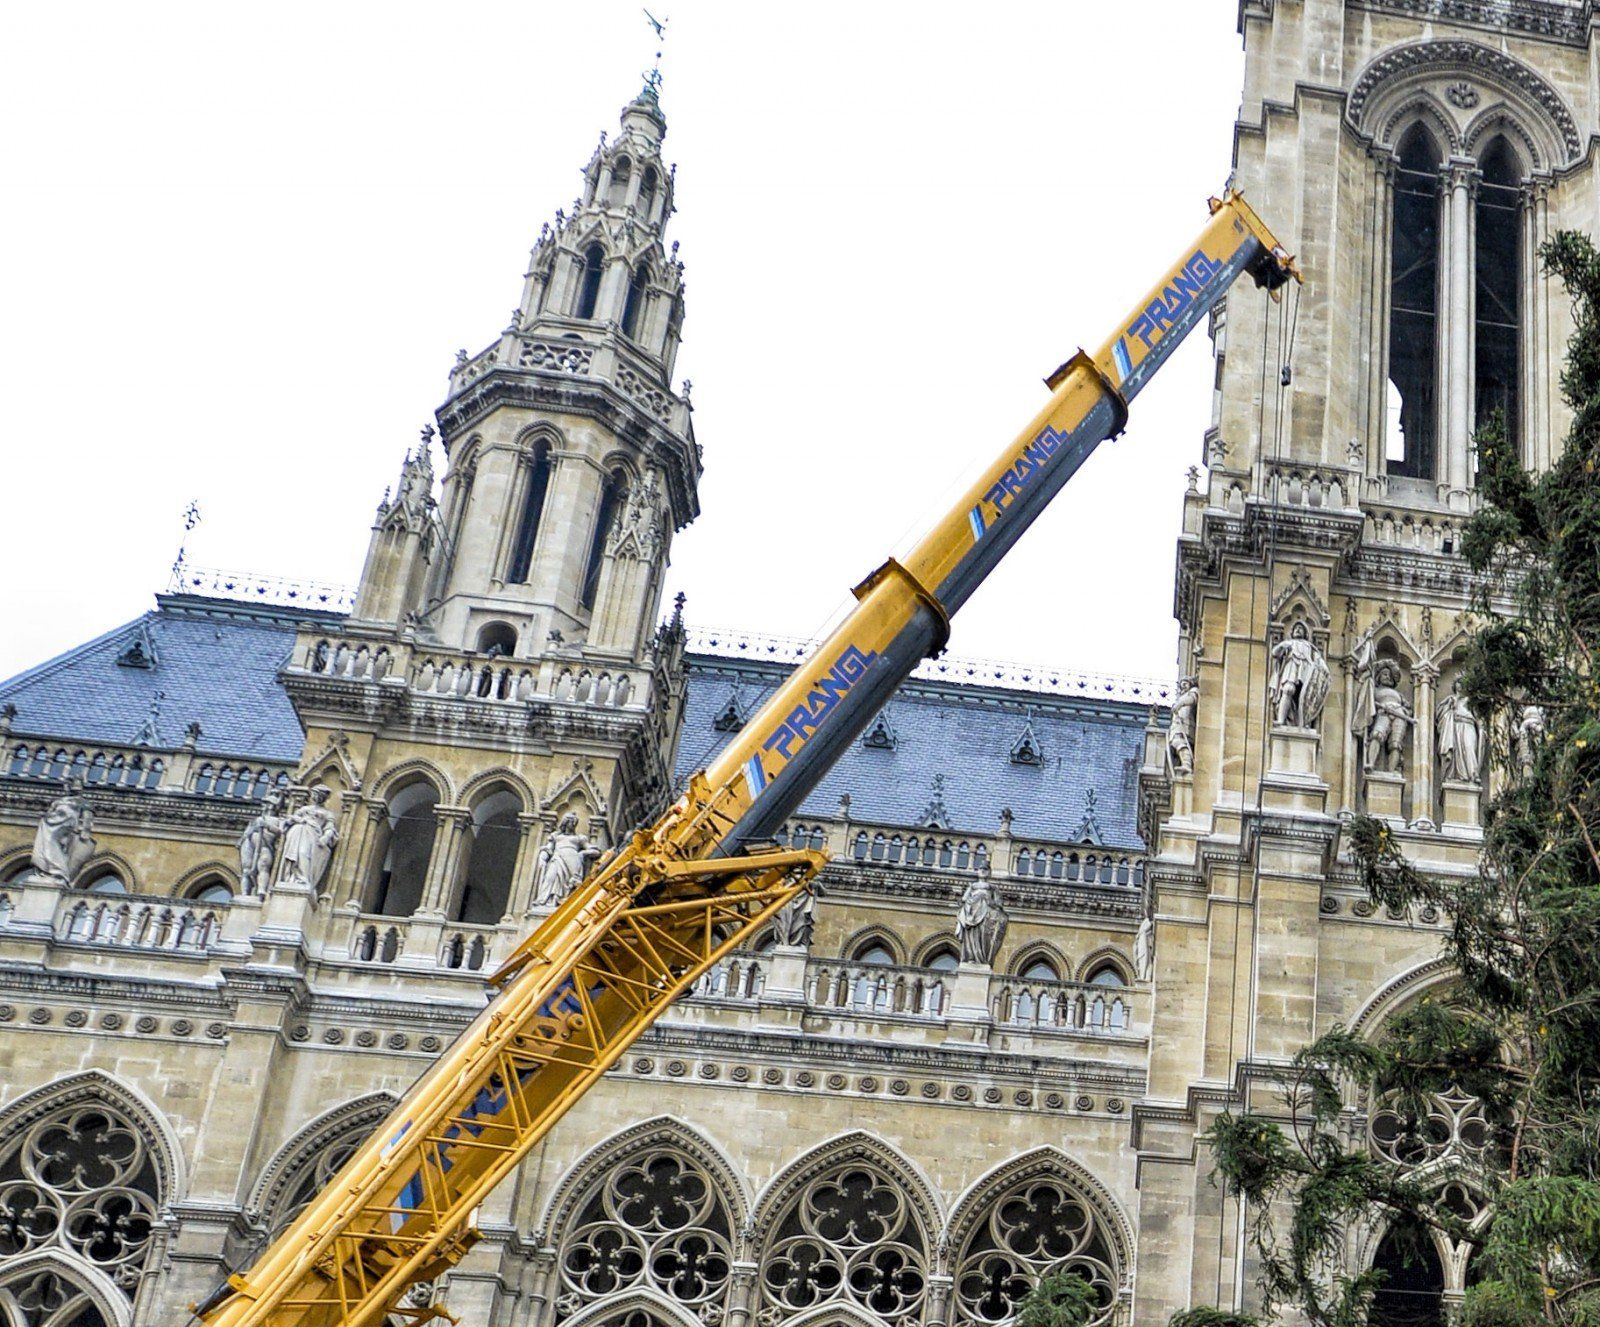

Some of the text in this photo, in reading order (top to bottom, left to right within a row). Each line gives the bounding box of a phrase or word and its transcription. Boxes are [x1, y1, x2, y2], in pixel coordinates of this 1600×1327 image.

[1126, 248, 1223, 349] PRANGL
[982, 424, 1070, 514] PRANGL
[762, 644, 877, 760] PRANGL
